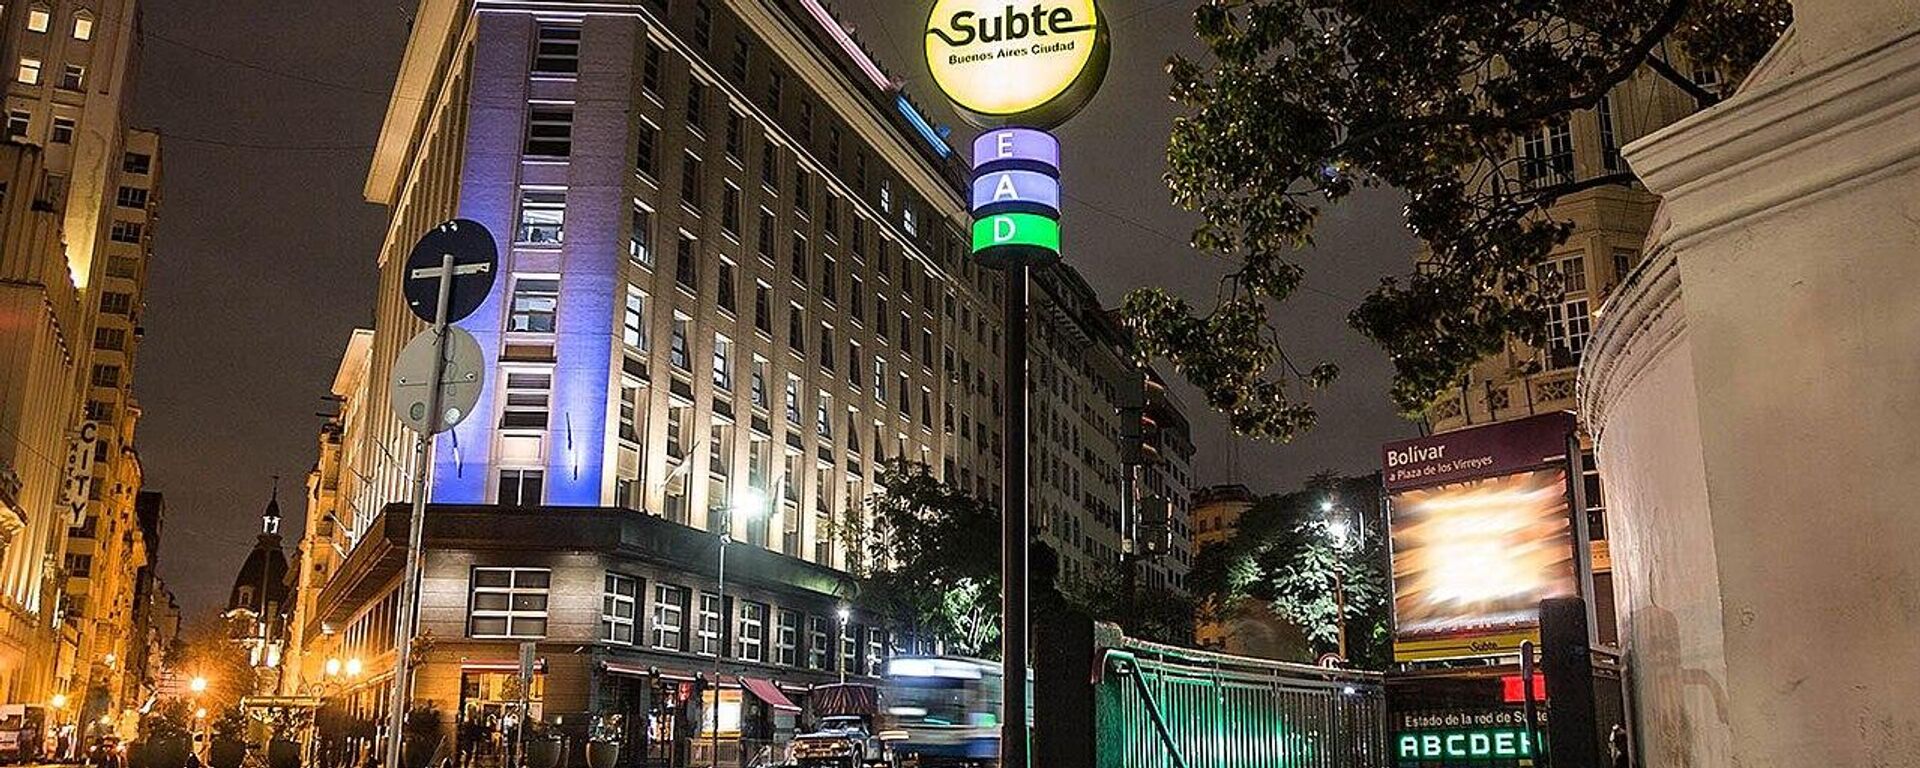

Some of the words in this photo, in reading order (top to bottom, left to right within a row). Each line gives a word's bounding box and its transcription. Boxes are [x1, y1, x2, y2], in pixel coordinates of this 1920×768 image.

[941, 5, 1079, 46] Subte
[948, 52, 993, 65] Buenos
[996, 48, 1028, 59] Aires
[1031, 40, 1075, 55] Ciudad
[997, 132, 1014, 158] E
[993, 173, 1019, 200] A
[993, 217, 1016, 242] D
[1387, 445, 1445, 467] Bolívar
[1389, 473, 1396, 481] a
[1397, 468, 1422, 480] Plaza
[1423, 464, 1436, 475] de
[1438, 462, 1452, 473] los
[1452, 456, 1493, 470] Virreyes
[71, 422, 97, 522] CITY
[1405, 714, 1443, 728] Estado
[1445, 713, 1459, 726] de
[1461, 713, 1472, 725] la
[1474, 711, 1494, 724] red
[1496, 712, 1511, 723] de
[1514, 710, 1548, 723] Ste
